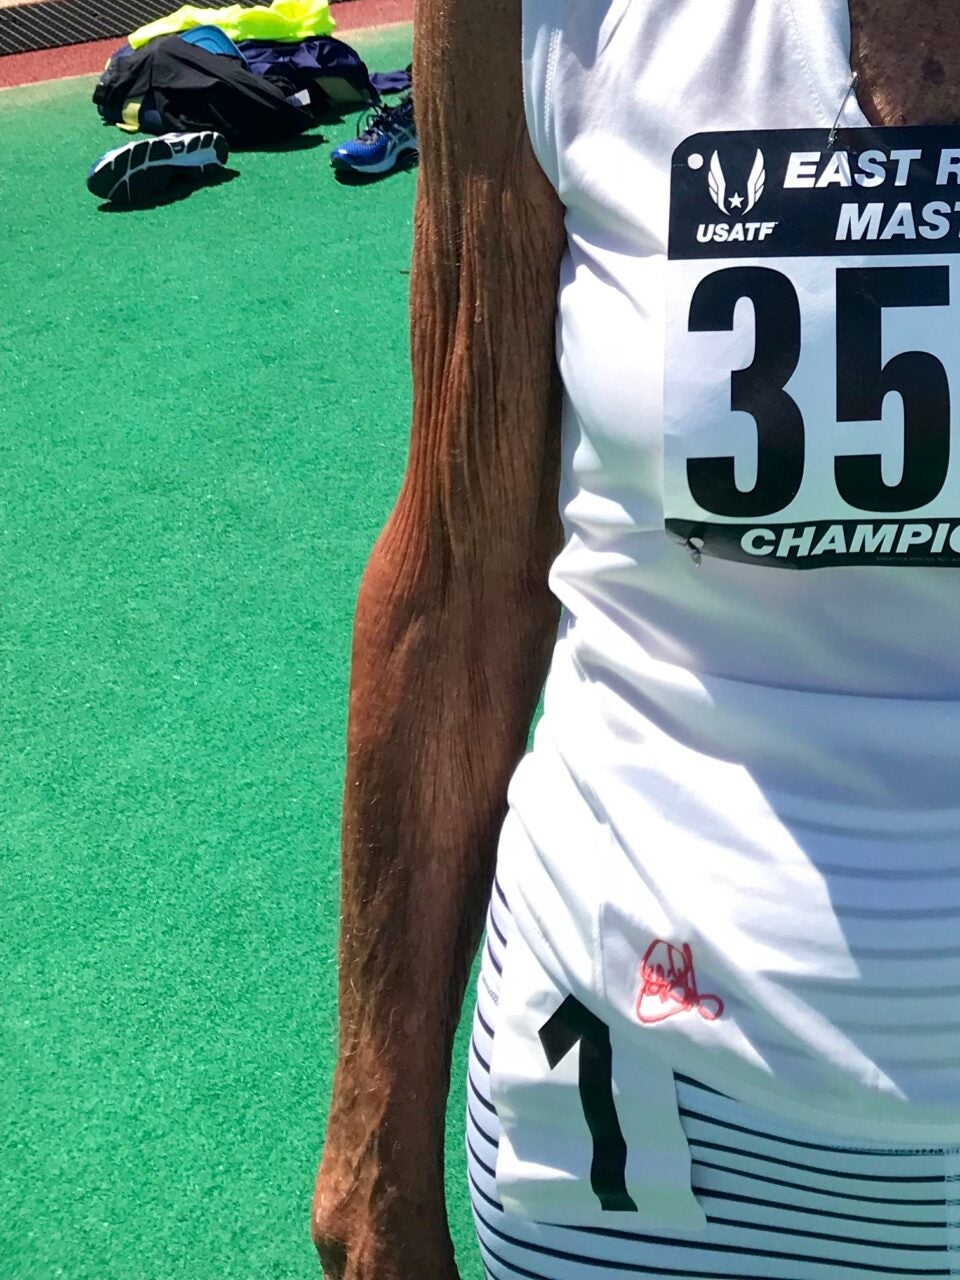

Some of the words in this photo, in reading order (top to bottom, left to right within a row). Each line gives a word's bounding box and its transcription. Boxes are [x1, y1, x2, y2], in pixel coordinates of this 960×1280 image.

[783, 149, 922, 189] EAST
[696, 221, 776, 243] USATF
[538, 993, 639, 1211] 1
